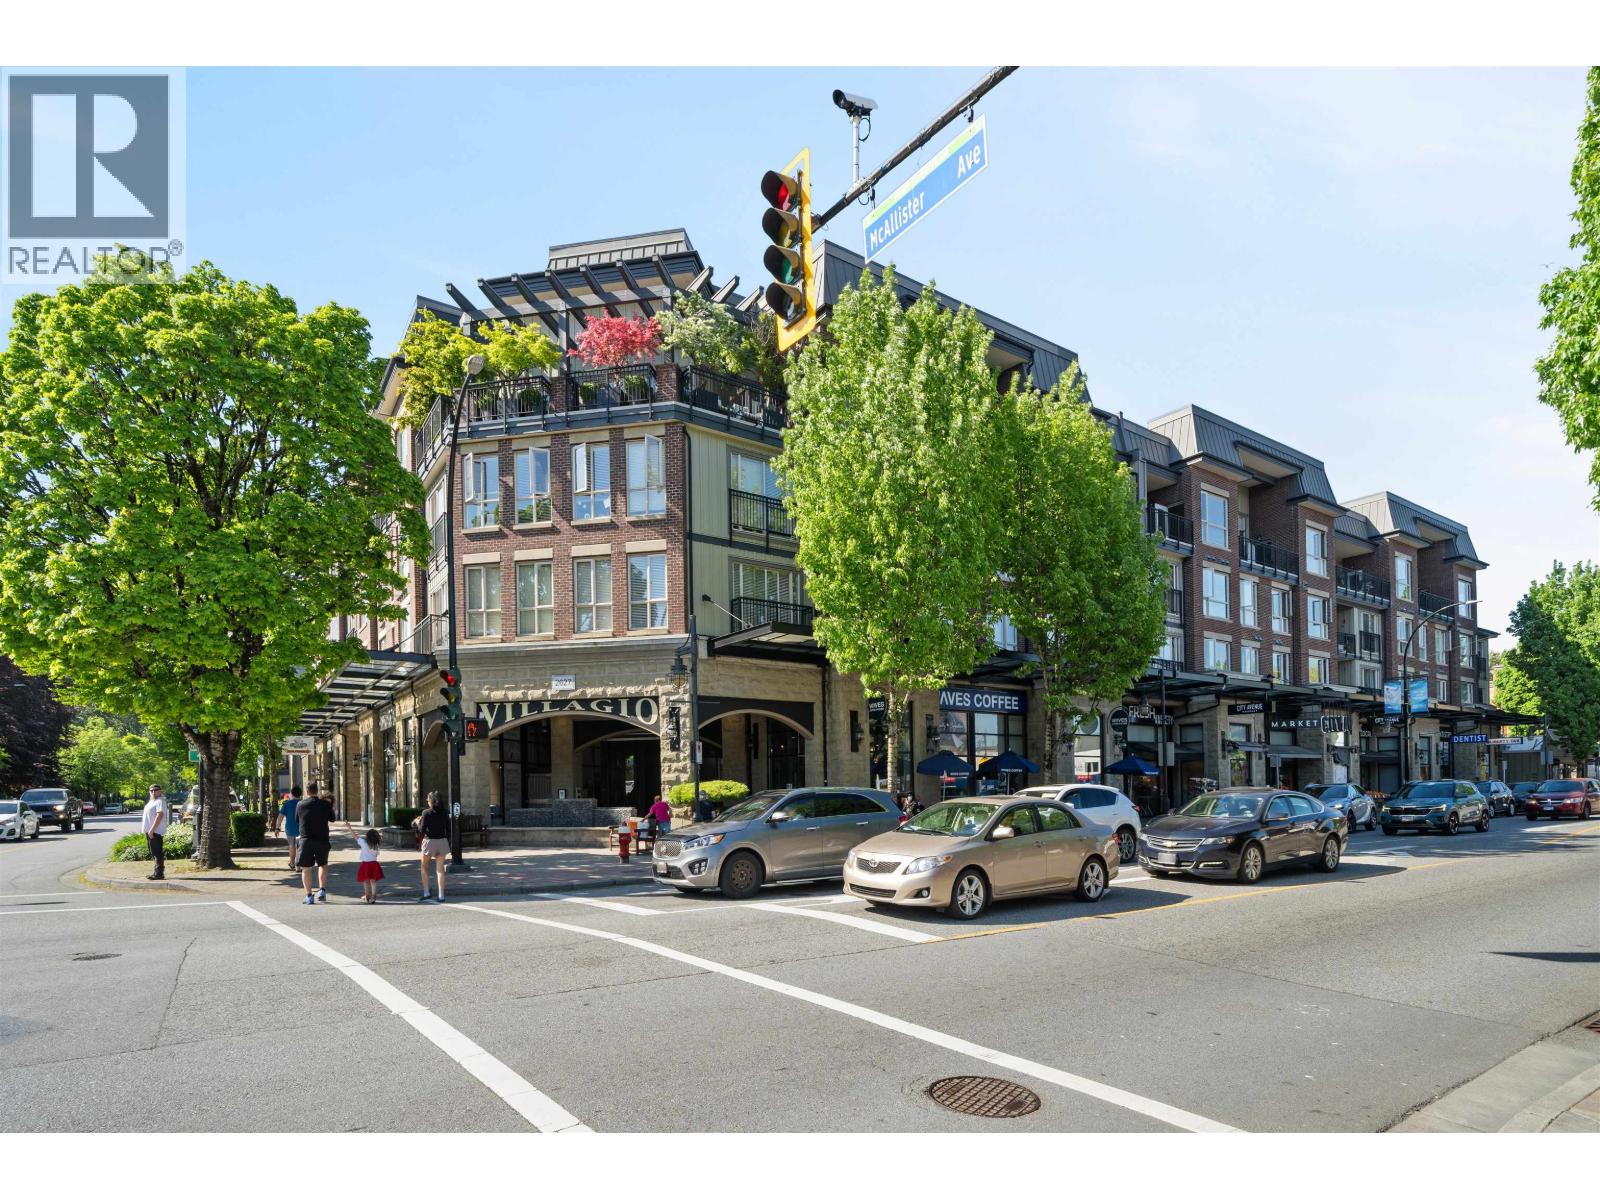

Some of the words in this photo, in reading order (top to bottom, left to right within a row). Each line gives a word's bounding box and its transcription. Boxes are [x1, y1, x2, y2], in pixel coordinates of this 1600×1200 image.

[869, 191, 925, 250] McAllister
[957, 144, 981, 178] Ave
[938, 690, 971, 707] AVES
[973, 693, 1019, 710] COFFEE
[479, 697, 659, 730] VILLAGIO
[1271, 720, 1318, 728] MARKET
[1453, 735, 1487, 743] DENTIST
